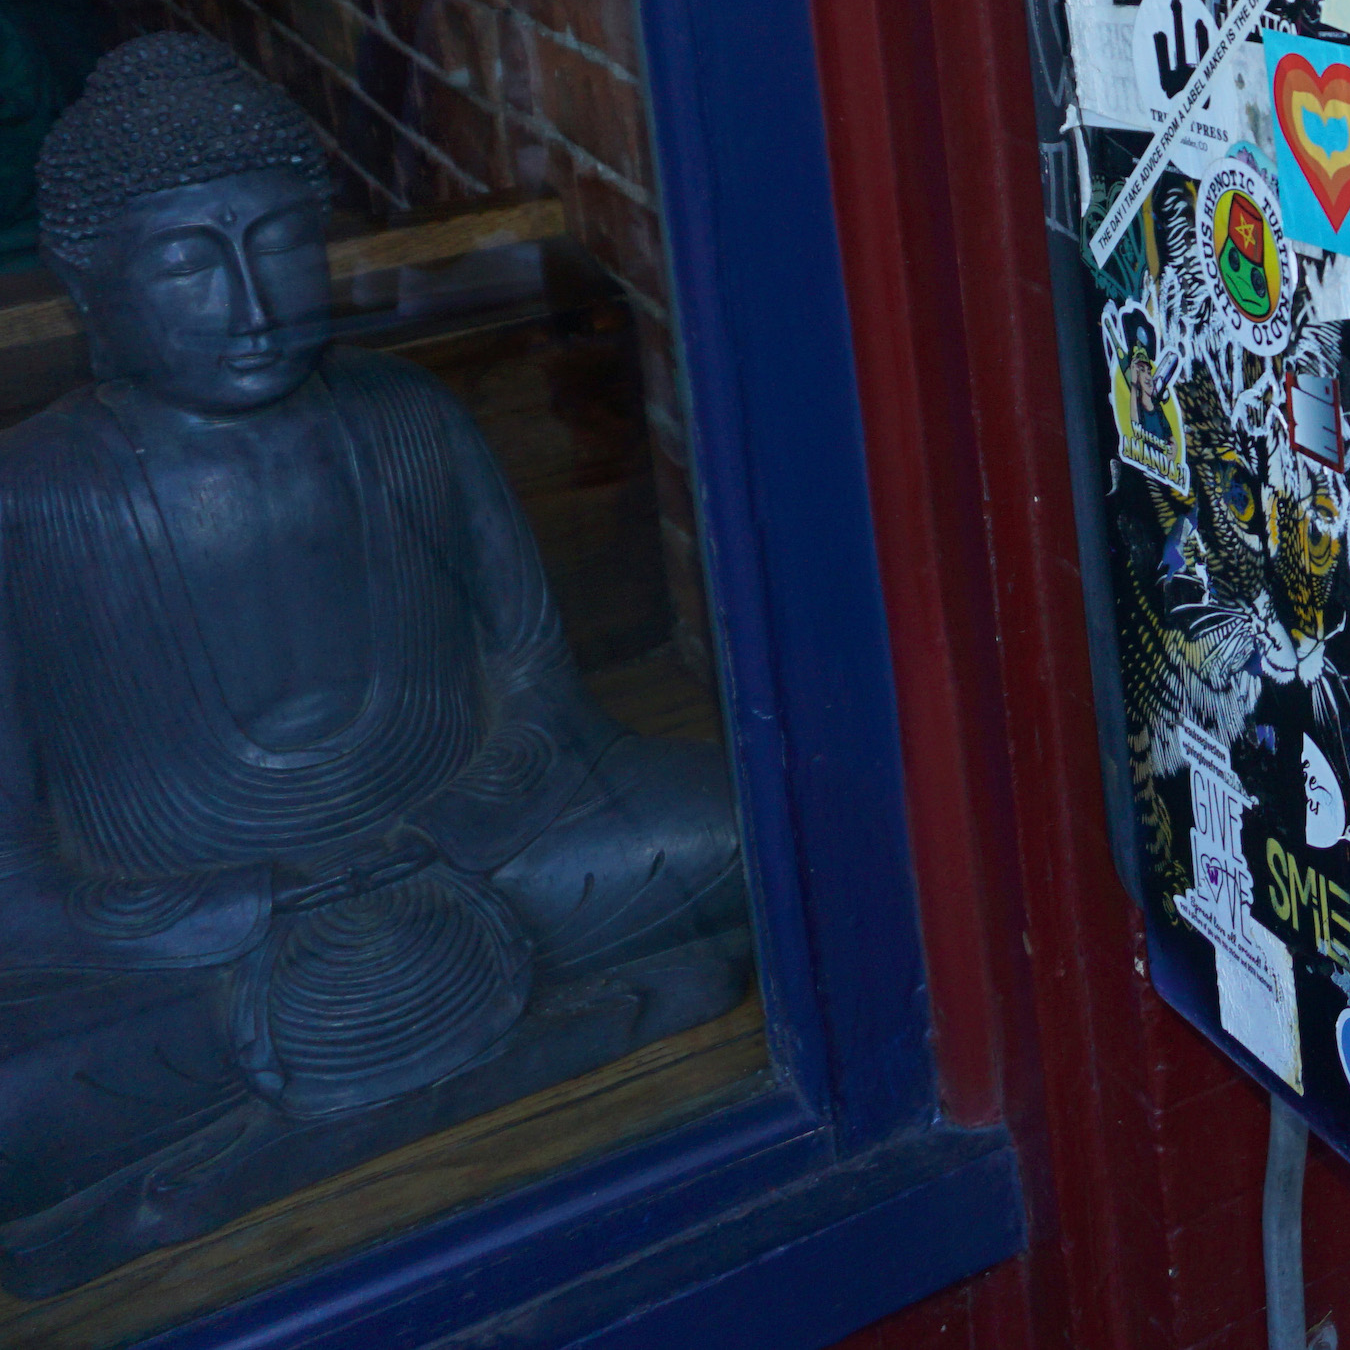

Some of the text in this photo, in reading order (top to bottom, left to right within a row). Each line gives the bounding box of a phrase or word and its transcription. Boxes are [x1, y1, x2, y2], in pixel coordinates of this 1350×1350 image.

[1097, 229, 1113, 251] THE
[1110, 211, 1125, 232] DAY
[1124, 180, 1143, 208] TAKE
[1140, 146, 1164, 183] ADVICE
[1162, 119, 1181, 153] FROM
[1183, 78, 1207, 115] LABEL
[1203, 39, 1230, 82] MAKER
[1226, 28, 1237, 45] IS
[1233, 3, 1251, 32] THE
[1201, 221, 1243, 331] CIRCUS
[1203, 169, 1290, 347] HYPNOTIC TURTLE RADIO
[1193, 769, 1243, 865] GIVE
